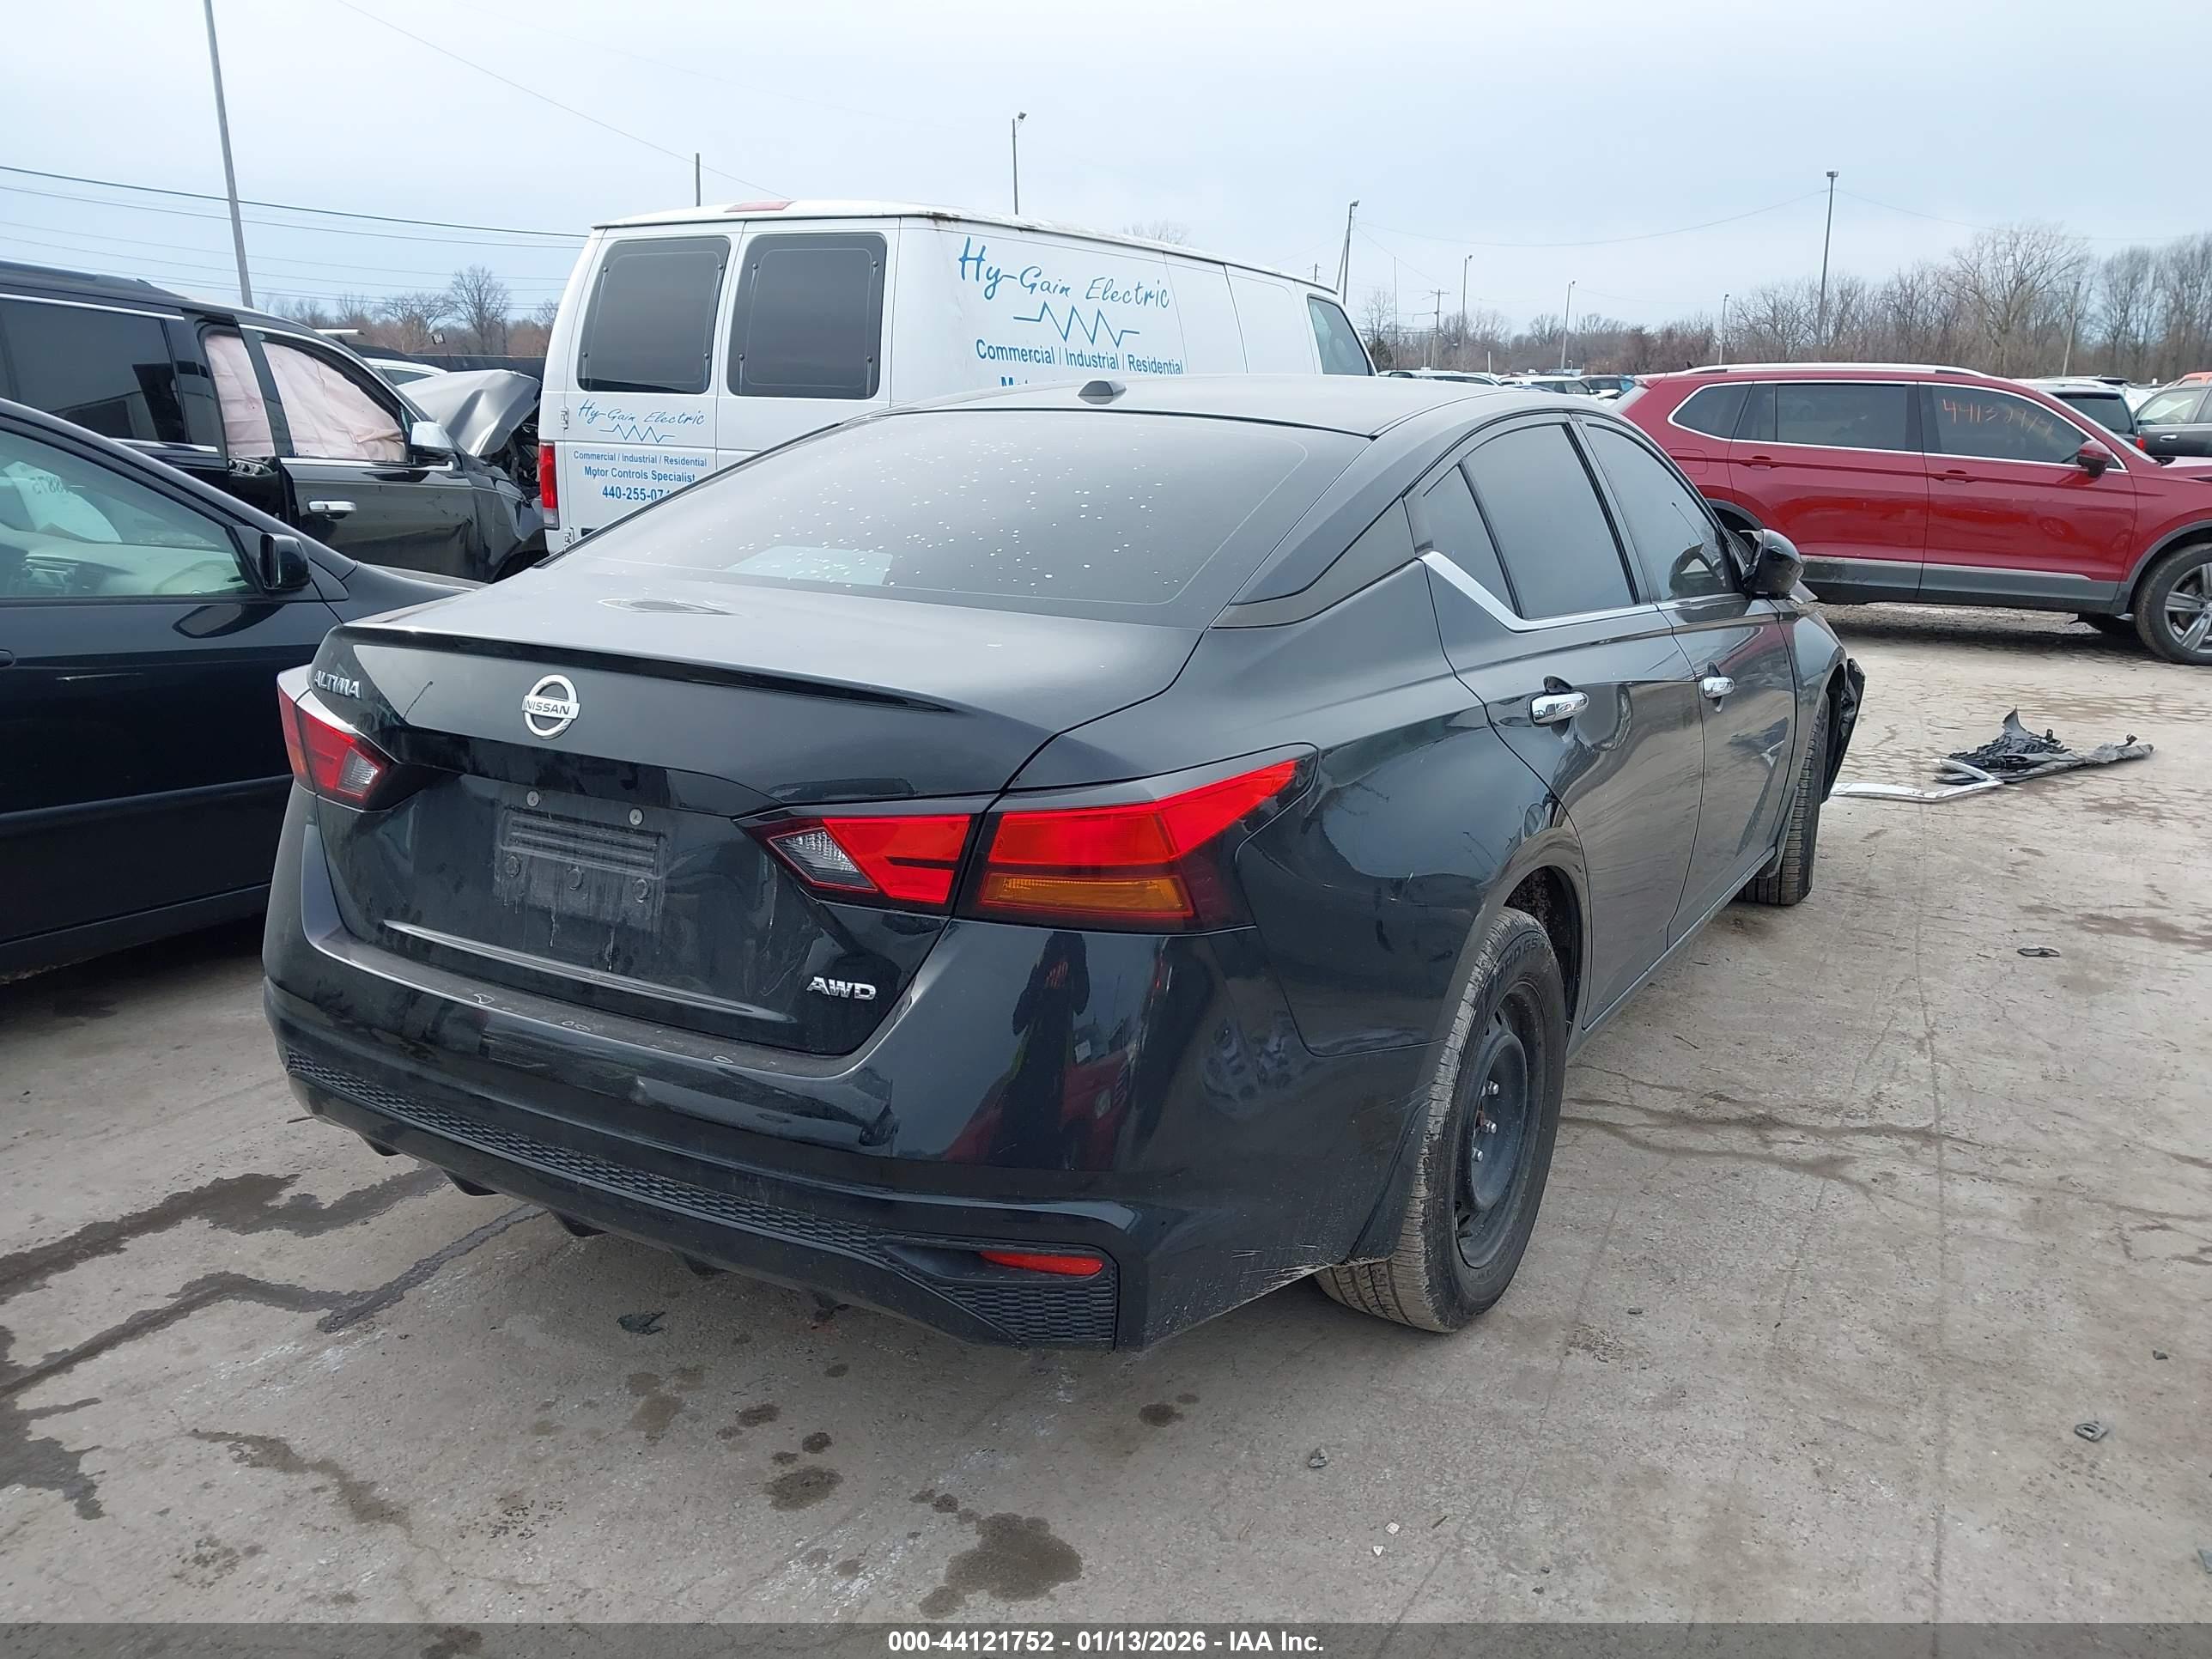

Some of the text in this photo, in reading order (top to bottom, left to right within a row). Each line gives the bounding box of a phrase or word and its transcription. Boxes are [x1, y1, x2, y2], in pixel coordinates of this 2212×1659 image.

[957, 236, 1170, 309] Hy-Gain Electric
[975, 339, 1056, 366] Commercial
[1065, 347, 1120, 370] Industrial
[1127, 354, 1184, 375] Residential
[577, 398, 706, 426] Hy-Gain Electric
[573, 450, 617, 462] Commercial
[622, 453, 658, 465] Industrial
[664, 455, 708, 467] Residential
[584, 466, 696, 483] Motor Controls Specialist
[602, 485, 671, 501] 440-255-07
[313, 669, 362, 699] ALTIMA
[525, 700, 571, 715] NISSAN
[805, 975, 877, 1000] AWD
